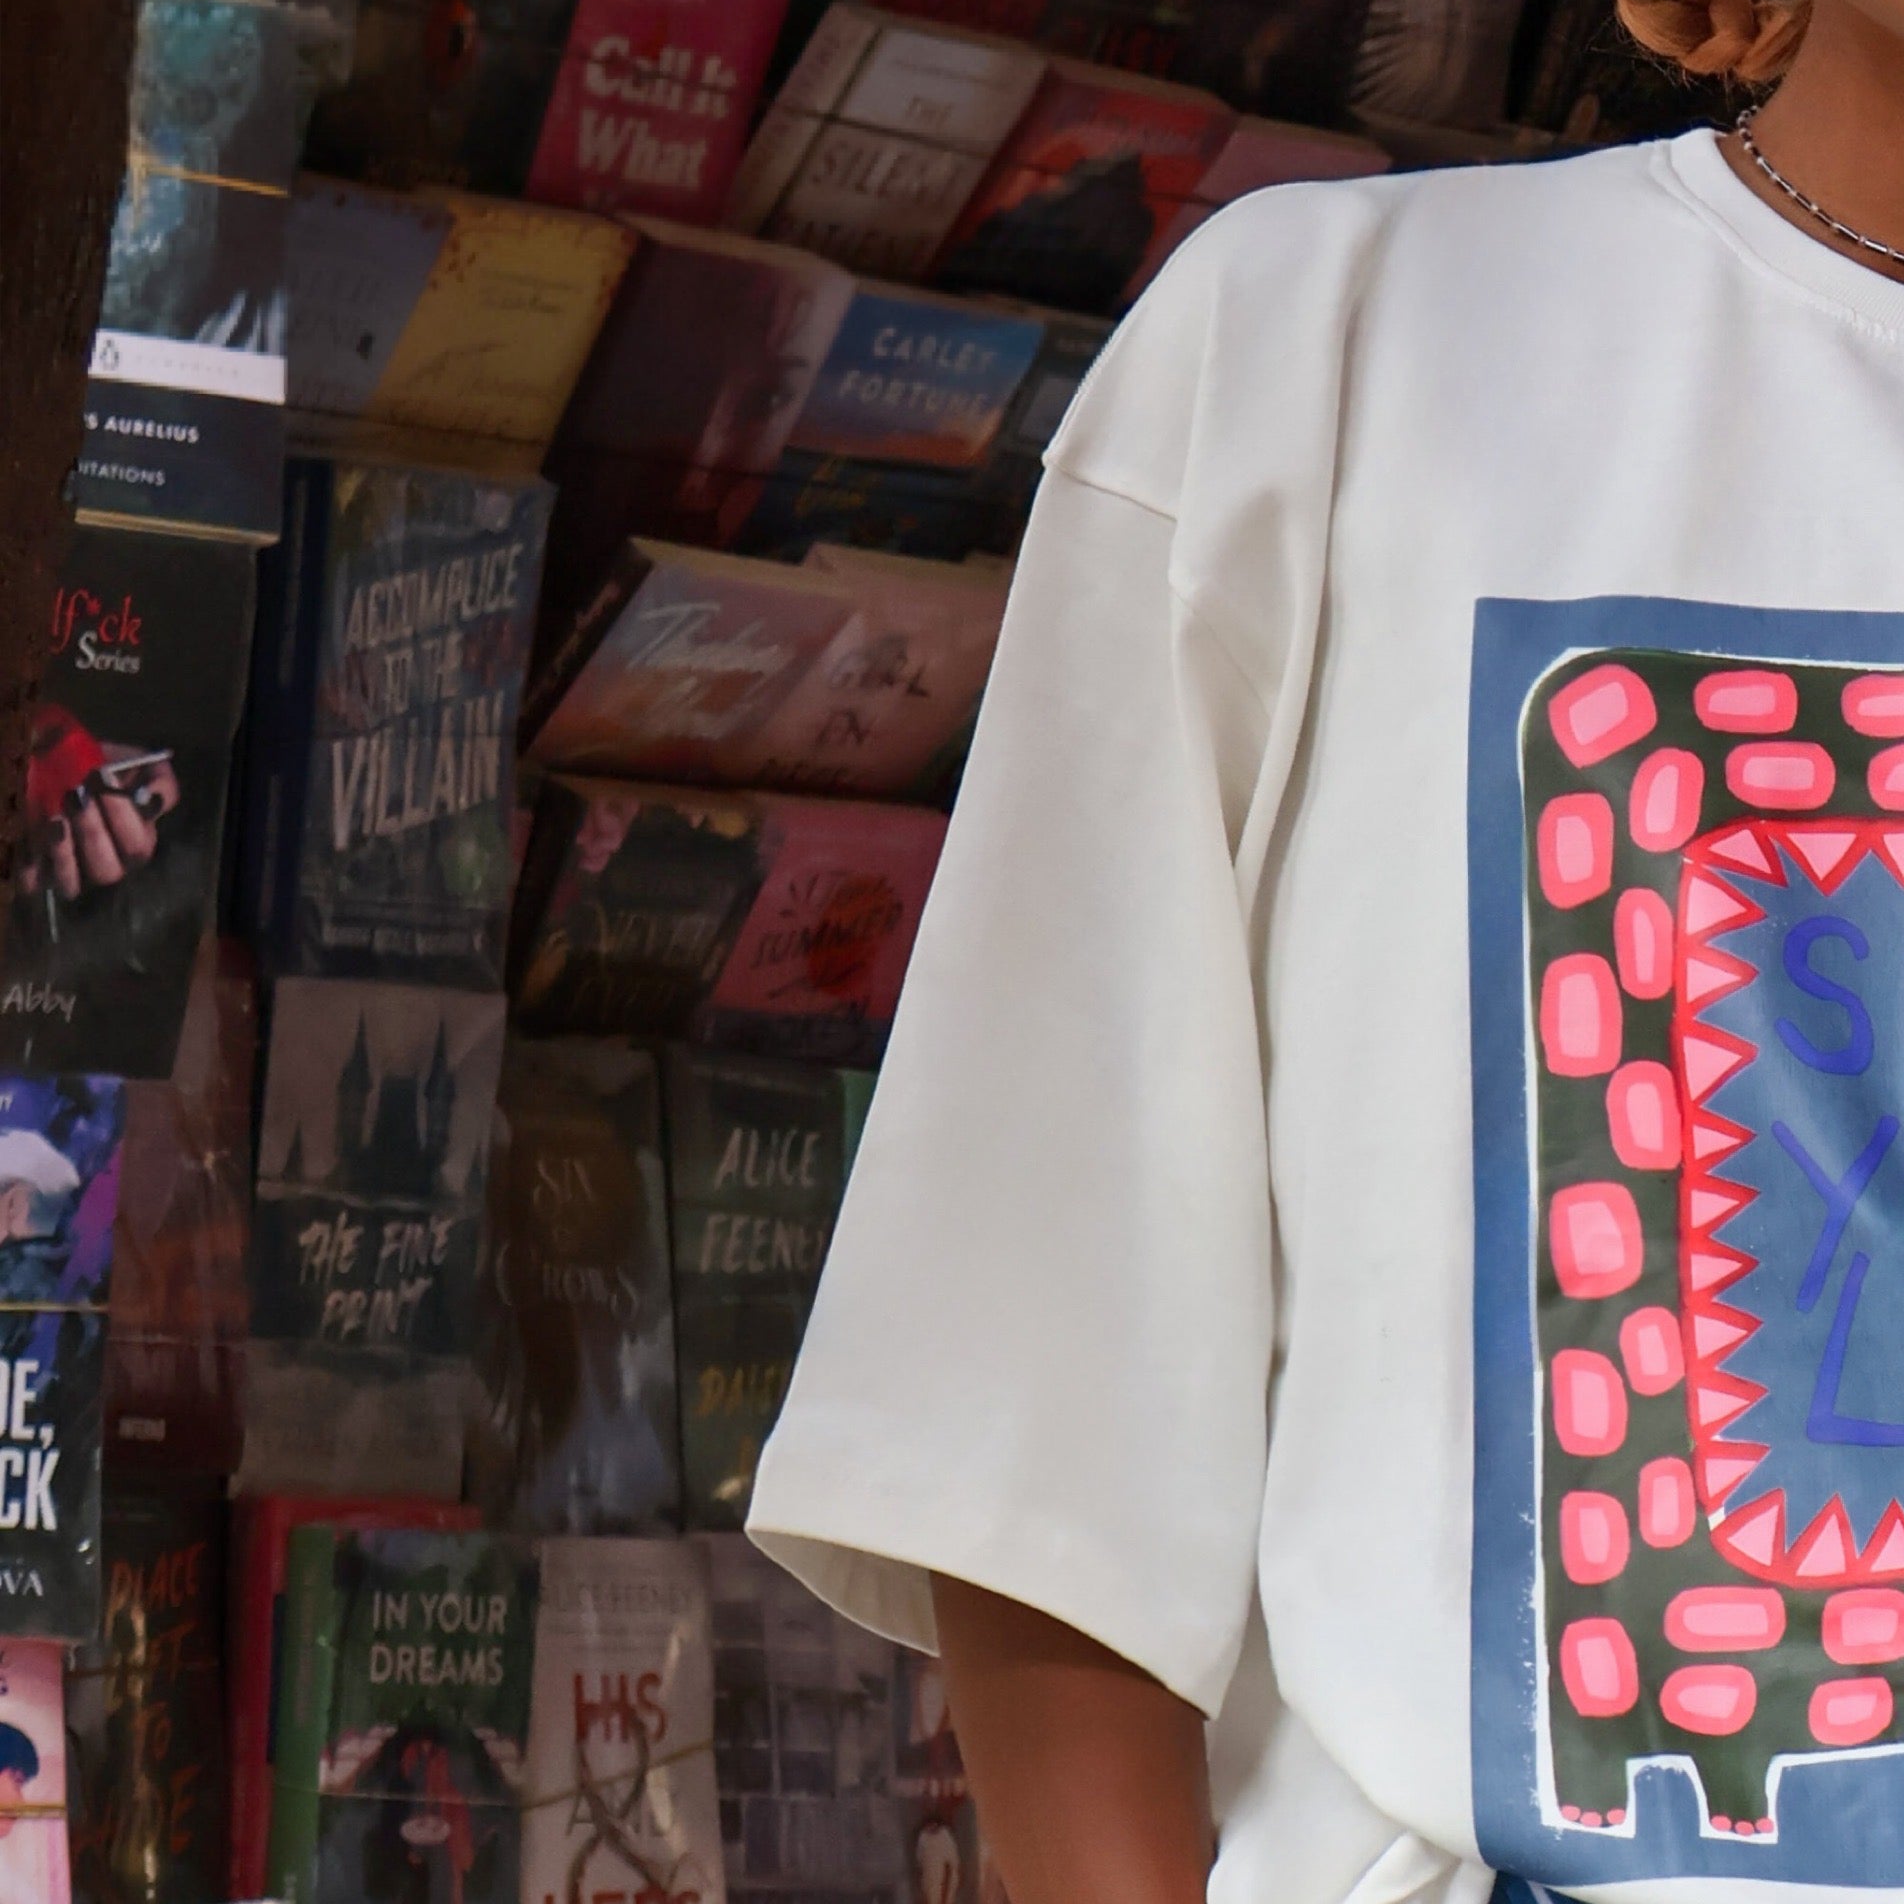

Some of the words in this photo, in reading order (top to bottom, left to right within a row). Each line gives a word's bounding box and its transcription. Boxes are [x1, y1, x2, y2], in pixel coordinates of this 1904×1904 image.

[575, 107, 709, 188] What
[872, 326, 999, 374] CARLEY
[839, 368, 999, 421] FORTUNE
[104, 414, 200, 445] AURELIUS
[74, 630, 142, 675] Series
[332, 689, 504, 853] VILLAIN
[4, 981, 77, 1026] Abby
[714, 1126, 822, 1191] ALICE
[298, 1208, 365, 1286] THE
[371, 1590, 408, 1634] IN
[418, 1592, 508, 1635] YOUR
[368, 1642, 505, 1688] DREAMS
[573, 1669, 668, 1744] HIS
